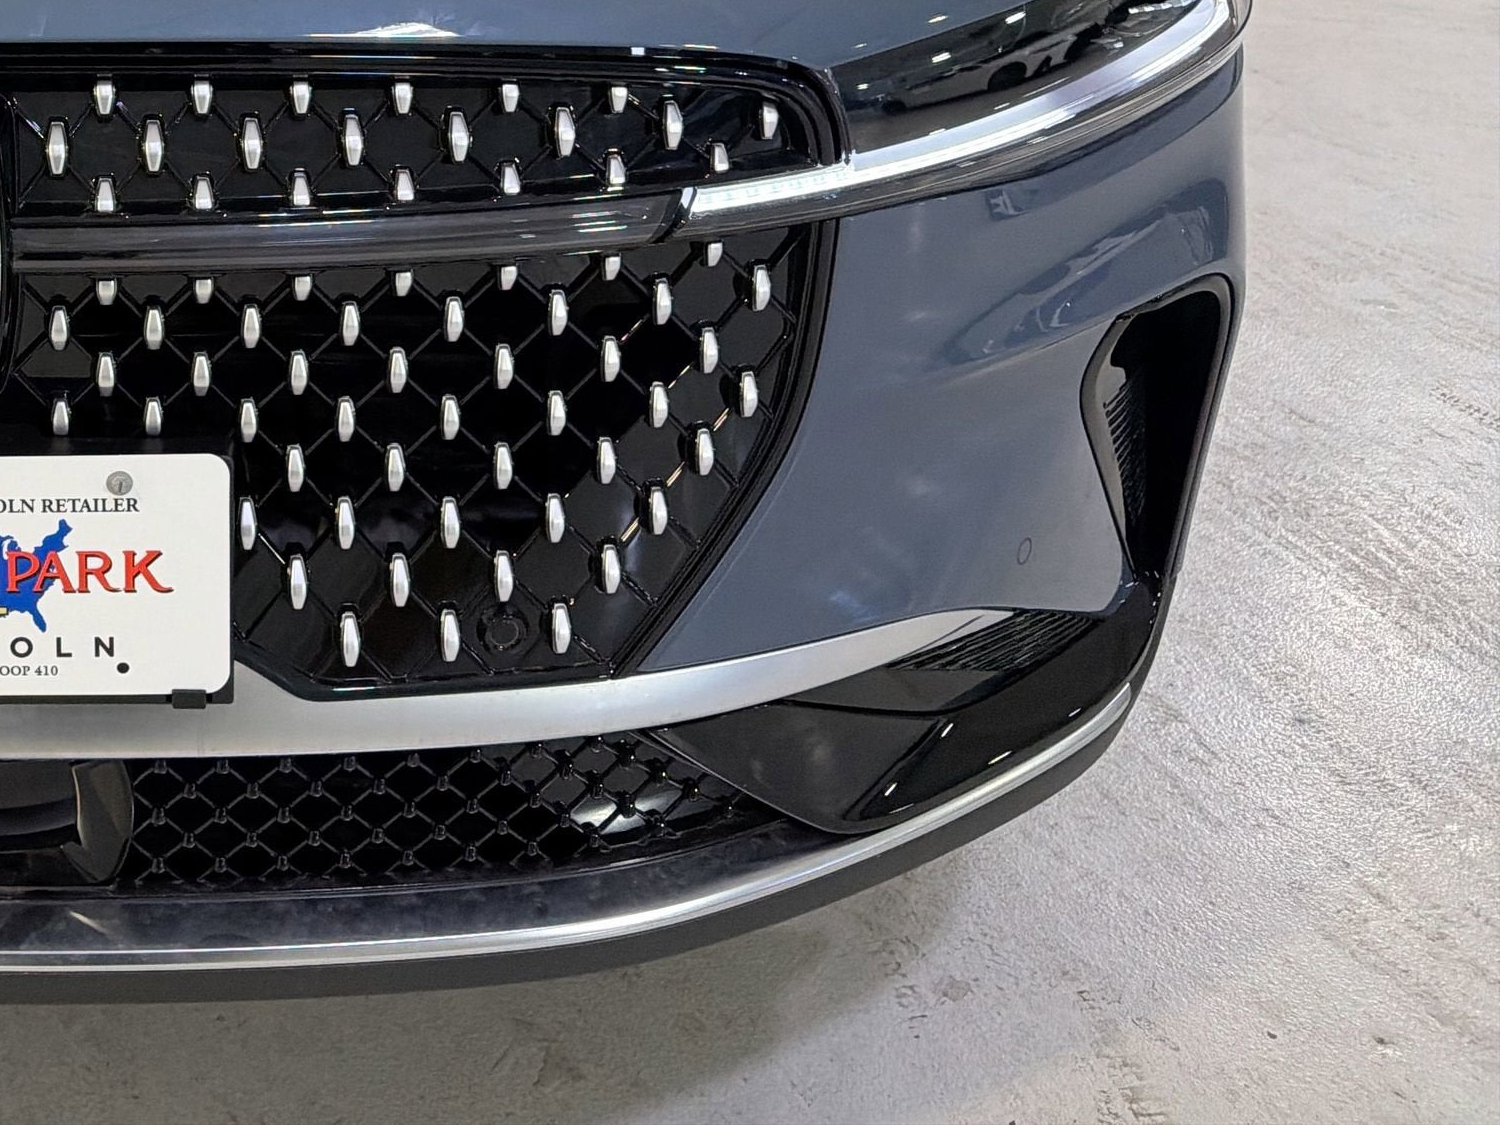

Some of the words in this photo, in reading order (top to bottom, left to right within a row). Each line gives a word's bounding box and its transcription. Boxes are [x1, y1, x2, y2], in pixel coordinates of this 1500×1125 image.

[41, 497, 140, 513] RETAILER
[5, 549, 174, 595] PARK
[35, 665, 59, 677] 410
